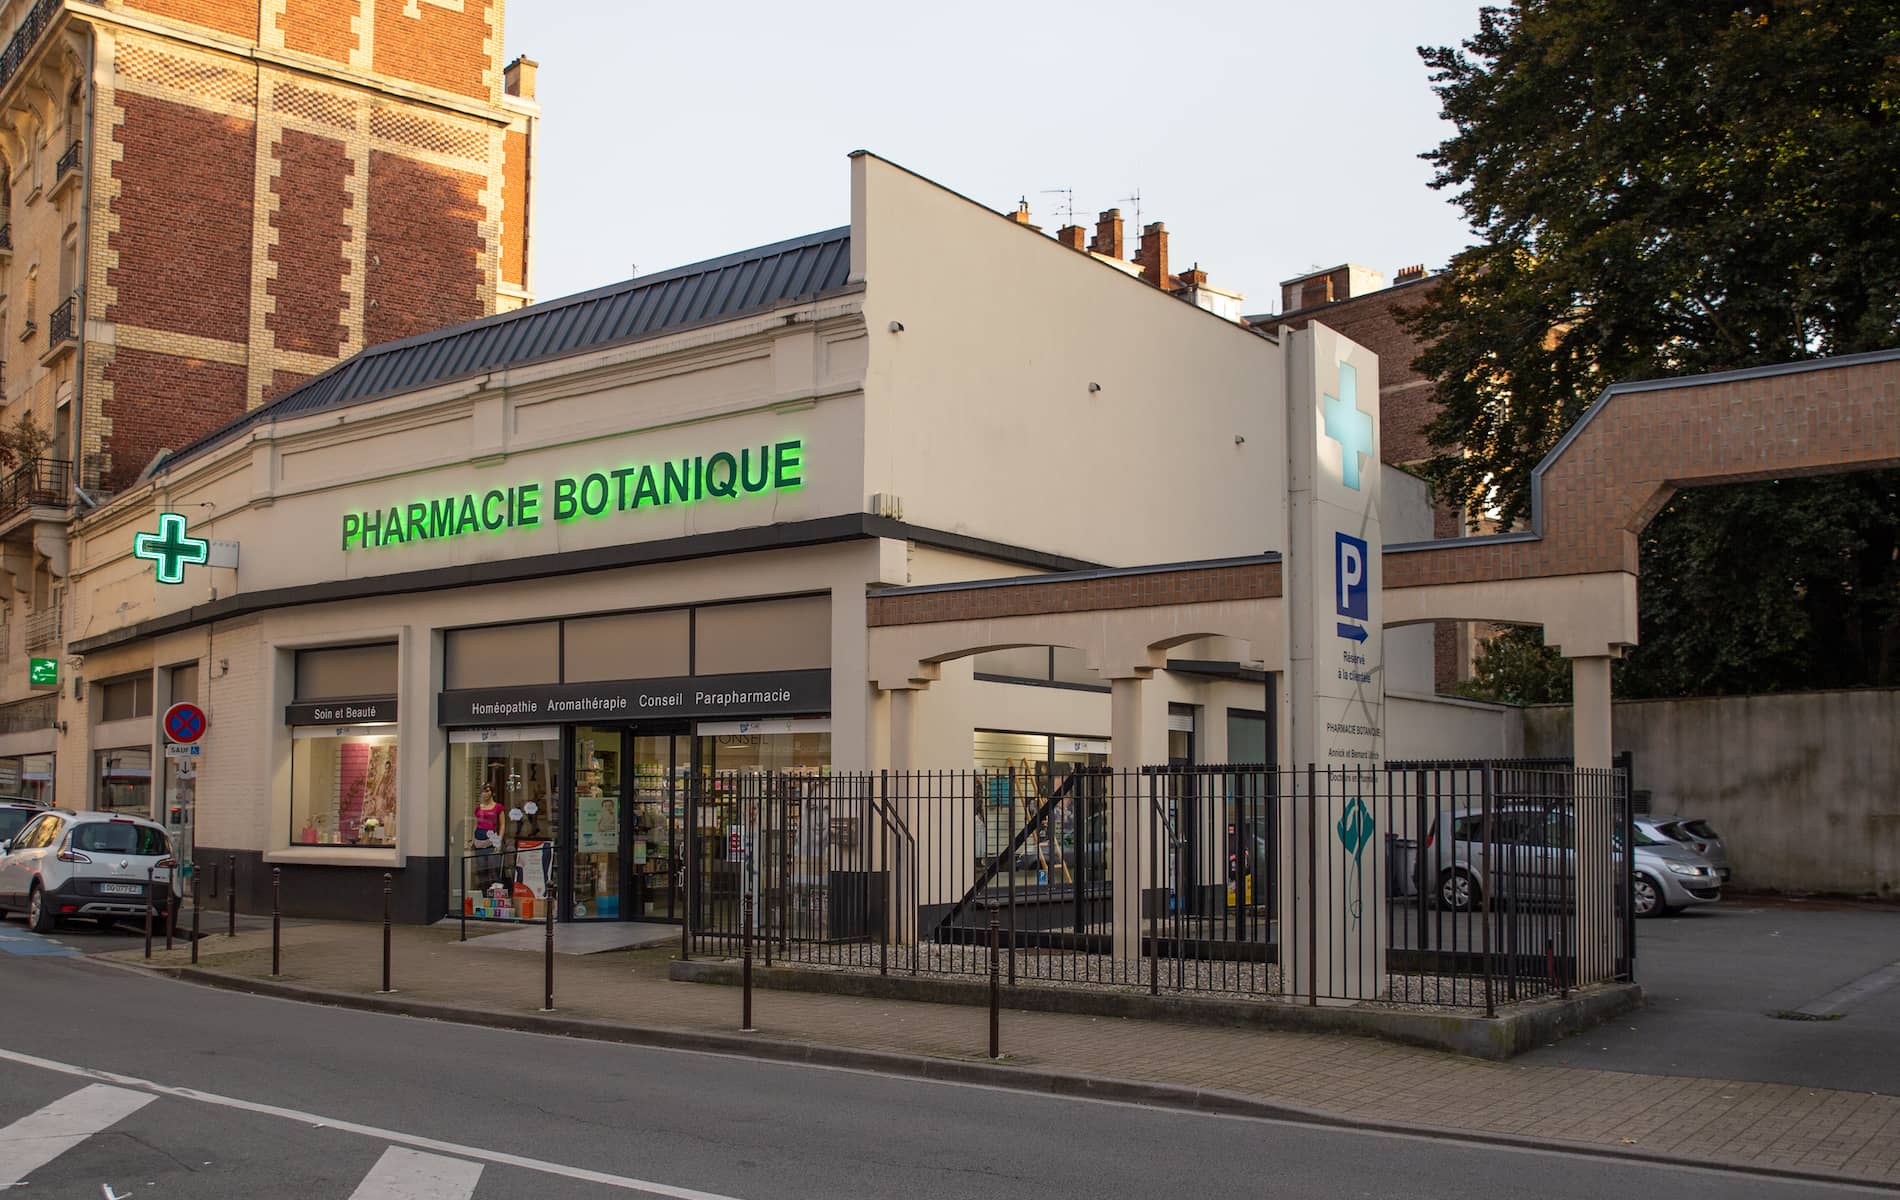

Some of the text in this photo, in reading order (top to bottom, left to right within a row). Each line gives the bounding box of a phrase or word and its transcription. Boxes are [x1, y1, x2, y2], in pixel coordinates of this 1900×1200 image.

[342, 440, 801, 551] PHARMACIE BOTANIQUE
[1341, 542, 1362, 608] P
[314, 706, 376, 720] Soin et Beauté
[472, 688, 791, 716] Homéopathie Aromathérapie Conseil Parapharmacie
[718, 734, 769, 745] ONSEIL
